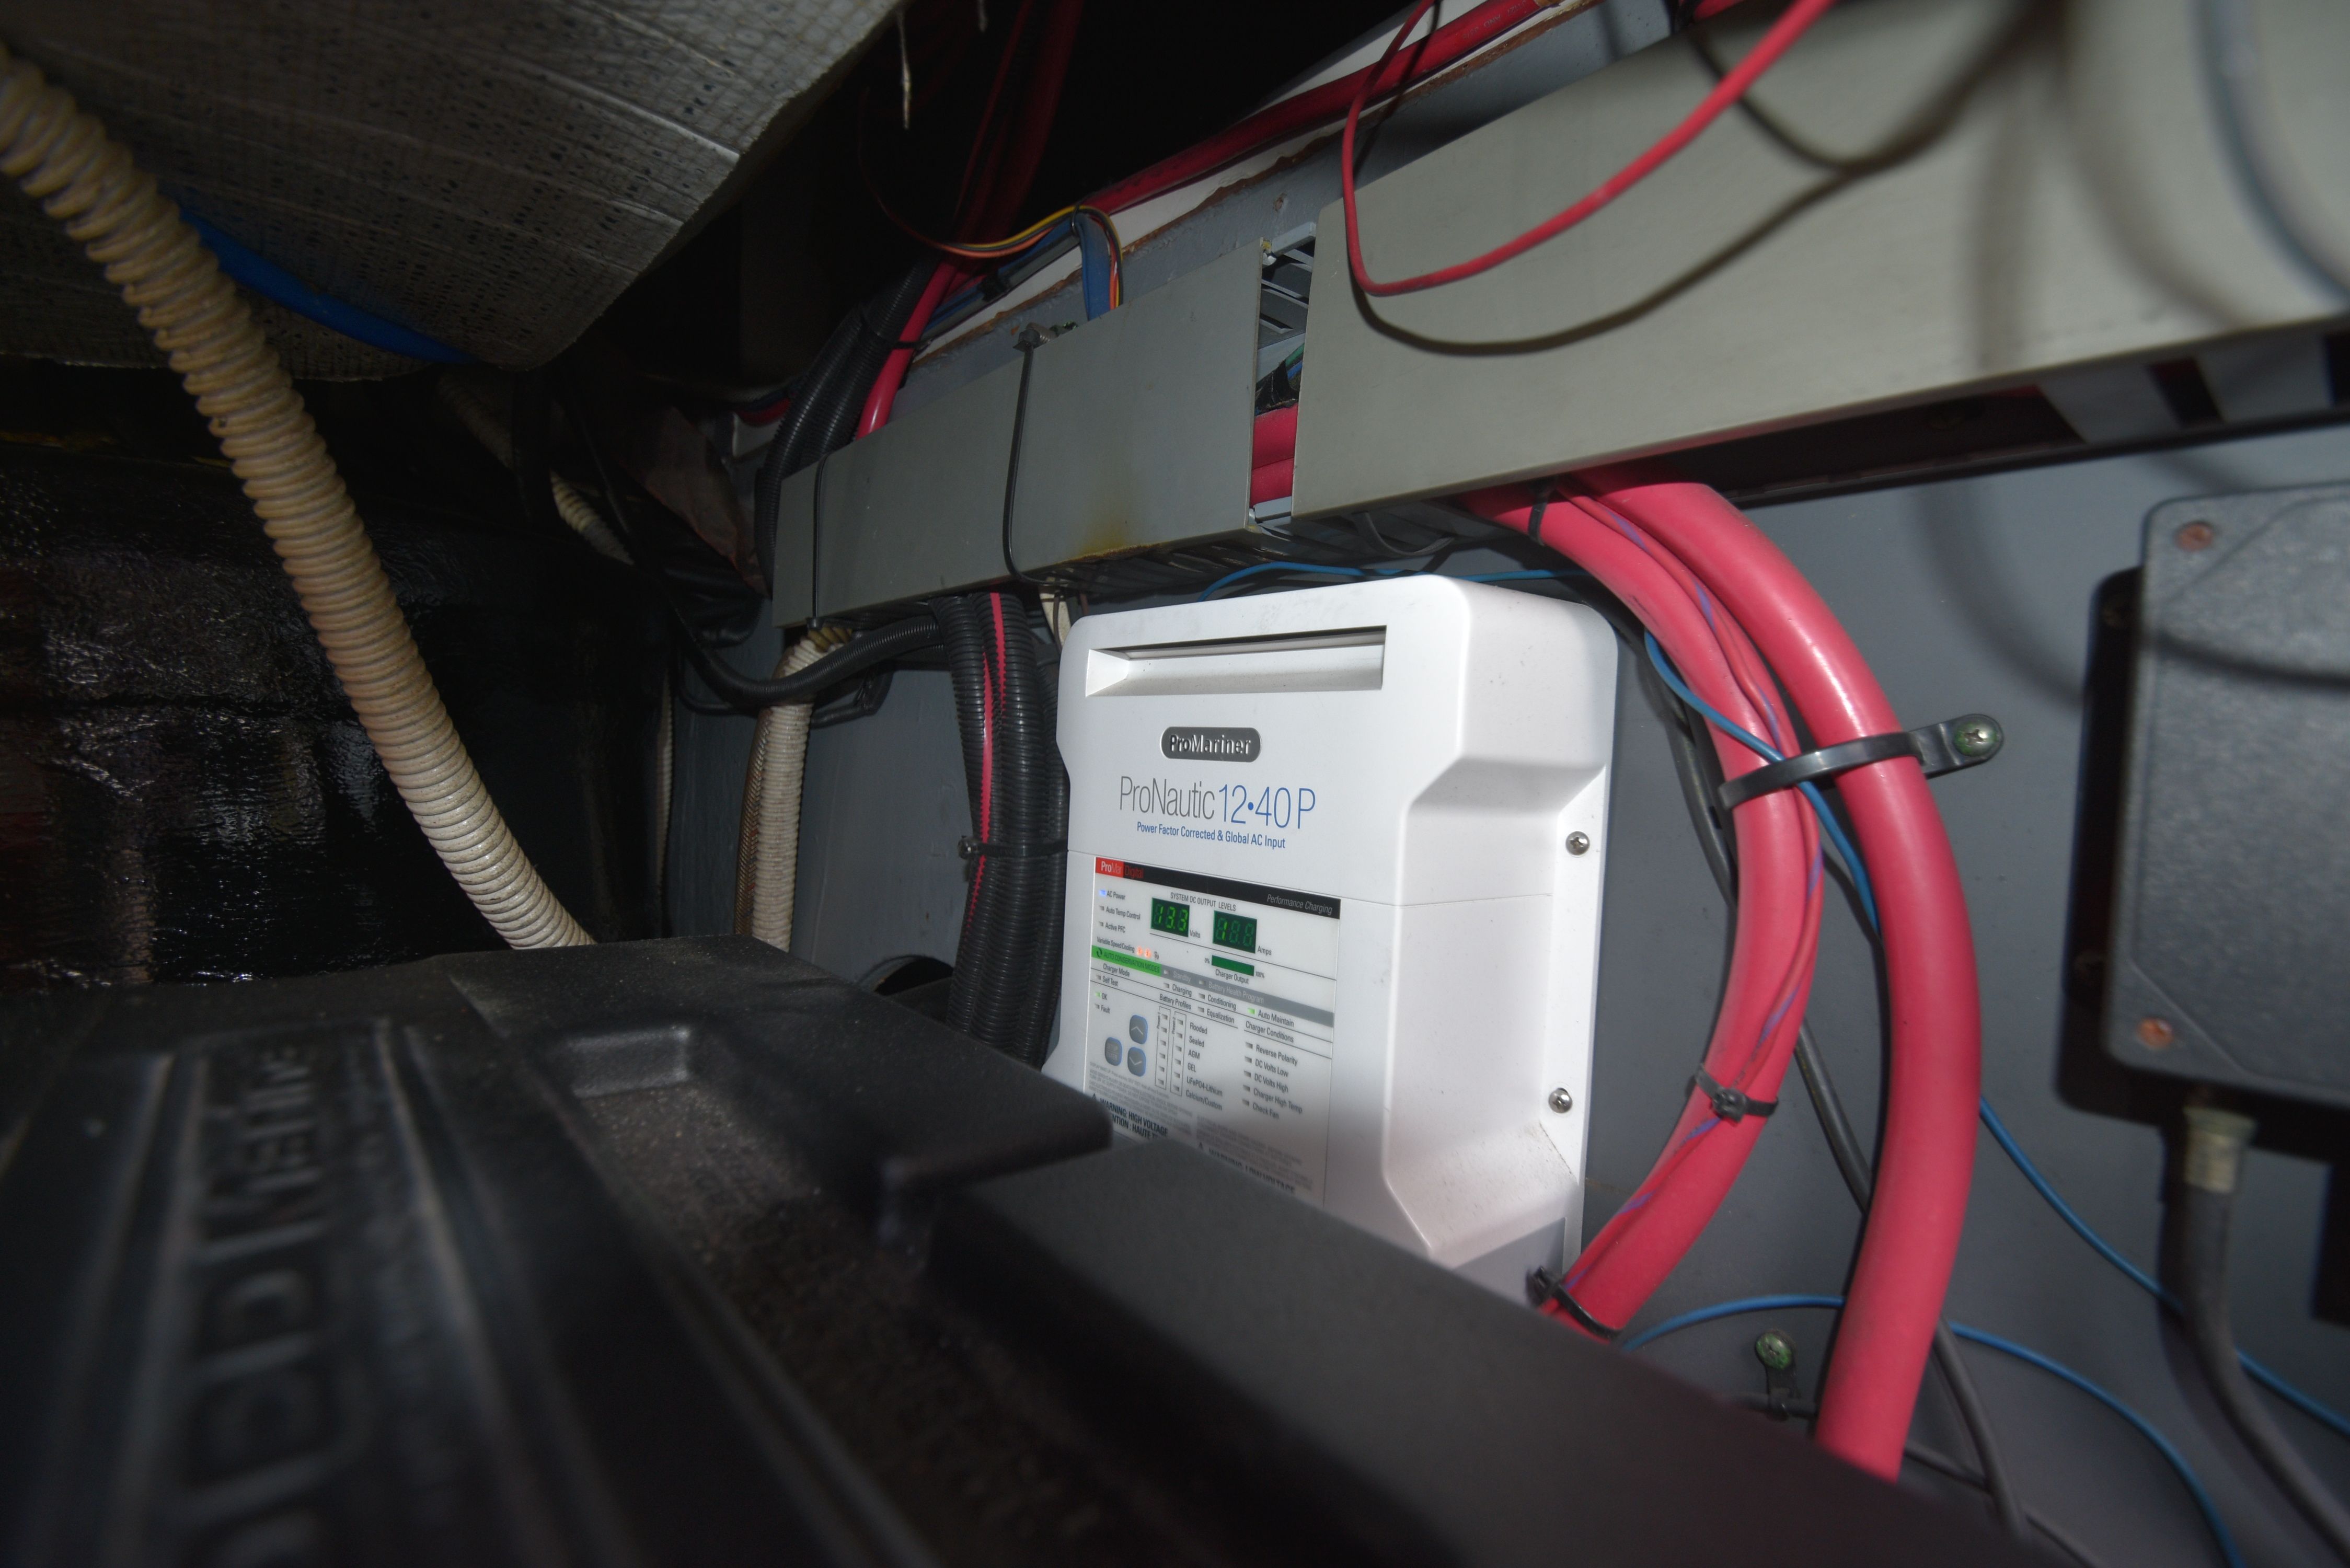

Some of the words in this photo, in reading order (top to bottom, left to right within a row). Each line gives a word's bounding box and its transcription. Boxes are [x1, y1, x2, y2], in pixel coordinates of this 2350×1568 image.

[1169, 734, 1251, 755] ProMariner
[1120, 776, 1215, 820] ProNautic
[1137, 822, 1157, 834] Power
[1159, 824, 1179, 836] Factor
[1181, 826, 1215, 840] Corrected
[1217, 829, 1223, 841] &
[1225, 831, 1250, 845] Global
[1251, 834, 1262, 846] AC
[1265, 835, 1286, 850] Input
[1101, 861, 1122, 874] ProMar
[1125, 866, 1144, 879] Digital
[1113, 892, 1125, 900] Power
[1170, 892, 1189, 902] SYSTEM
[1197, 897, 1216, 908] OUTPUT
[1218, 902, 1236, 912] LEVELS
[1267, 894, 1303, 909] Performance
[1305, 901, 1332, 915] Charging
[1115, 908, 1125, 918] Temp
[1125, 910, 1141, 920] Control
[1105, 922, 1116, 930] Active
[1190, 929, 1201, 939] Volts
[1097, 936, 1110, 946] Variable
[1111, 940, 1121, 949] Speed
[1122, 942, 1135, 953] Cooling
[1258, 946, 1272, 956] Amps
[1104, 952, 1114, 960] AUTO
[1114, 954, 1145, 969] CONSERVATION
[1145, 963, 1160, 973] MODES
[1215, 969, 1233, 979] Charger
[1234, 973, 1249, 985] Output
[1103, 963, 1118, 973] Charger
[1119, 967, 1130, 976] Mode
[1172, 984, 1192, 997] Charging
[1207, 994, 1236, 1011] Conditioning
[1258, 1010, 1270, 1020] Auto
[1271, 1013, 1294, 1028] Maintain
[1173, 971, 1191, 983] Standby
[1208, 981, 1225, 993] Battery
[1226, 985, 1242, 998] Health
[1242, 990, 1264, 1005] Program
[1101, 1005, 1110, 1013] Fault
[1110, 976, 1118, 986] Test
[1207, 1008, 1234, 1024] Equalization
[1159, 994, 1174, 1006] Battery
[1175, 999, 1191, 1010] Profiles
[1190, 1022, 1207, 1034] Flooded
[1246, 1021, 1265, 1033] Charger
[1266, 1027, 1294, 1043] Conditions
[1189, 1036, 1204, 1047] Sealed
[1188, 1049, 1200, 1060] AGM
[1256, 1044, 1276, 1058] Reverse
[1277, 1052, 1297, 1067] Polarity
[1187, 1063, 1196, 1073] GEL
[1255, 1059, 1263, 1068] DC
[1263, 1061, 1276, 1073] Volts
[1277, 1066, 1288, 1078] Low
[1254, 1073, 1262, 1083] DC
[1263, 1076, 1275, 1088] Volts
[1276, 1080, 1288, 1093] High
[1186, 1089, 1222, 1111] Calcium/Custom
[1253, 1087, 1273, 1102] Charger
[1275, 1094, 1287, 1108] High
[1288, 1100, 1303, 1114] Temp
[1252, 1102, 1268, 1115] Check
[1269, 1107, 1279, 1120] Fan
[1128, 1111, 1142, 1123] HIGH
[1143, 1117, 1168, 1136] VOLTAGE
